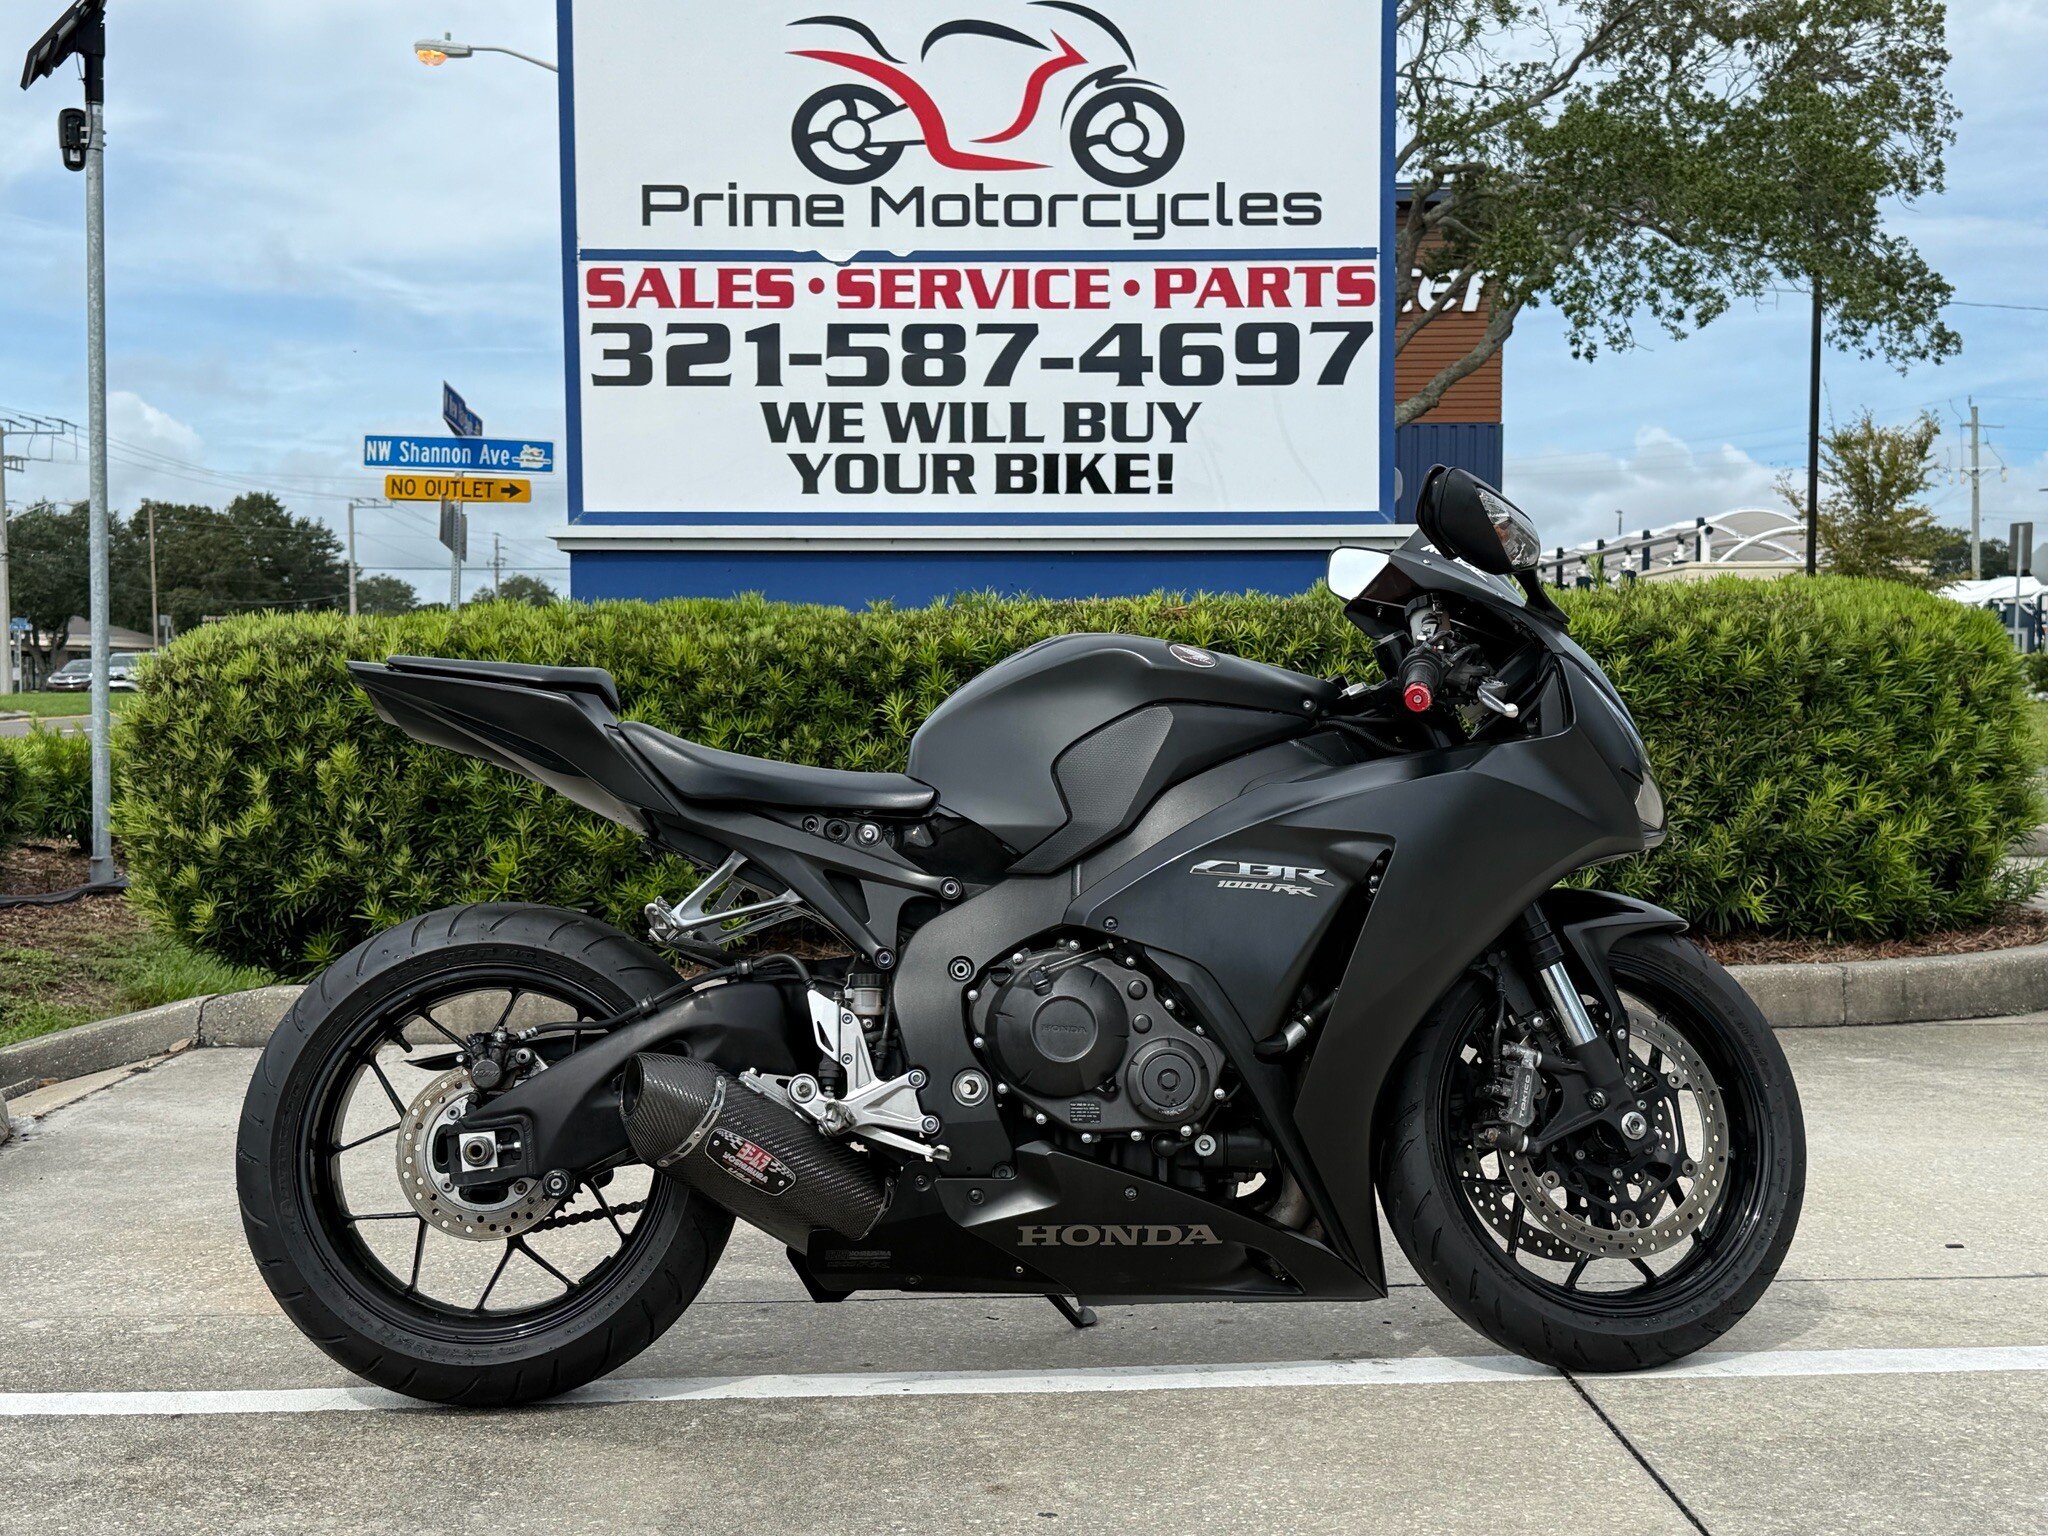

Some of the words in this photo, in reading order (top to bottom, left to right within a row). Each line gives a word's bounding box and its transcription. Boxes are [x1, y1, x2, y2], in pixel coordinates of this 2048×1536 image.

[642, 181, 844, 227] Prime
[871, 182, 1323, 241] Motorcycles
[586, 267, 794, 309] SALES
[837, 268, 1109, 309] SERVICE
[1154, 265, 1375, 309] PARTS
[590, 321, 1374, 387] 321-587-4697
[760, 402, 865, 443] WE
[881, 402, 1045, 443] WILL
[1062, 402, 1203, 443] BUY
[366, 440, 392, 462] NW
[399, 441, 472, 464] Shannon
[479, 444, 510, 466] Ave
[391, 478, 416, 495] NO
[425, 480, 494, 498] OUTLET
[787, 453, 977, 494] YOUR
[994, 453, 1174, 495] BIKE!
[1190, 860, 1335, 887] CBR
[1040, 1023, 1088, 1034] HONDA
[1519, 1074, 1531, 1118] TOKICO
[1017, 1224, 1223, 1246] HONDA
